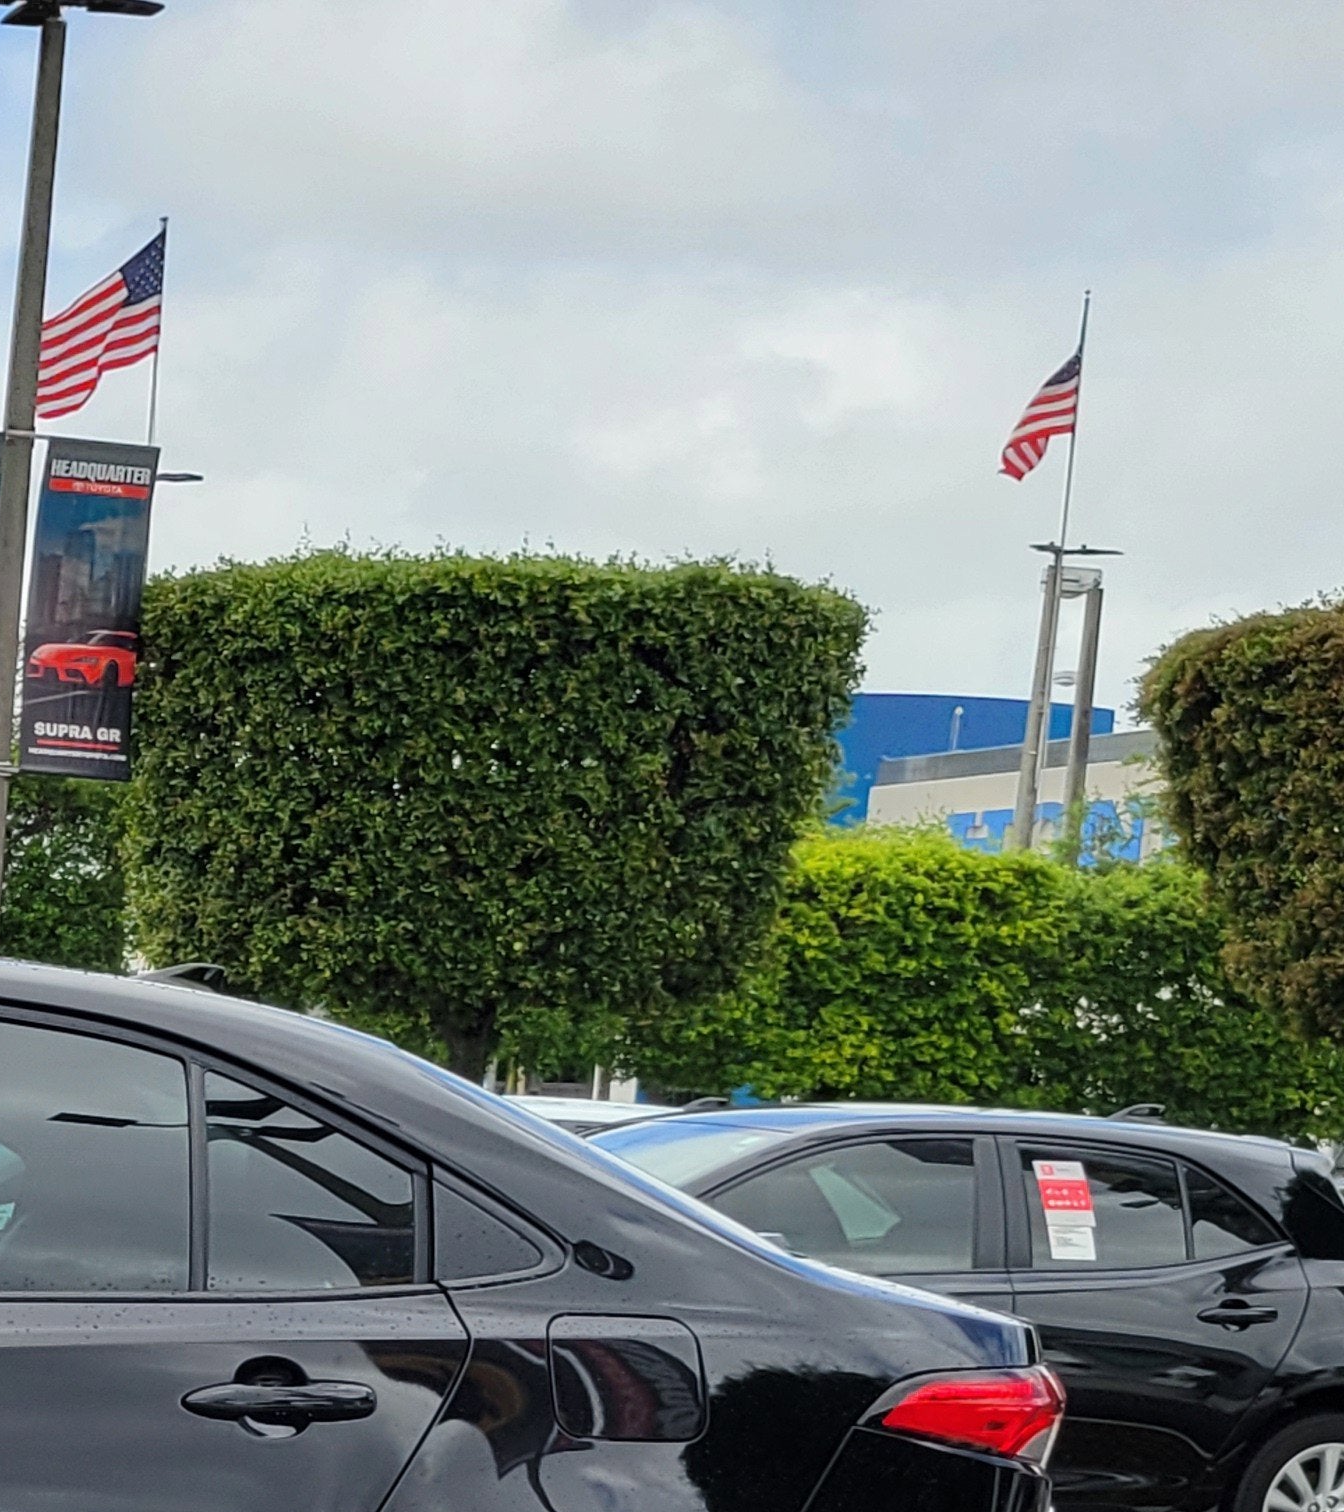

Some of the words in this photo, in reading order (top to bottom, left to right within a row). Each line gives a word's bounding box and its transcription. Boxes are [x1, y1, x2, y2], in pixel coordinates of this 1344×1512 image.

[50, 459, 151, 485] HEADQUARTER
[85, 484, 123, 494] TOYOTA
[33, 722, 93, 740] SUPRA
[96, 728, 122, 742] GR
